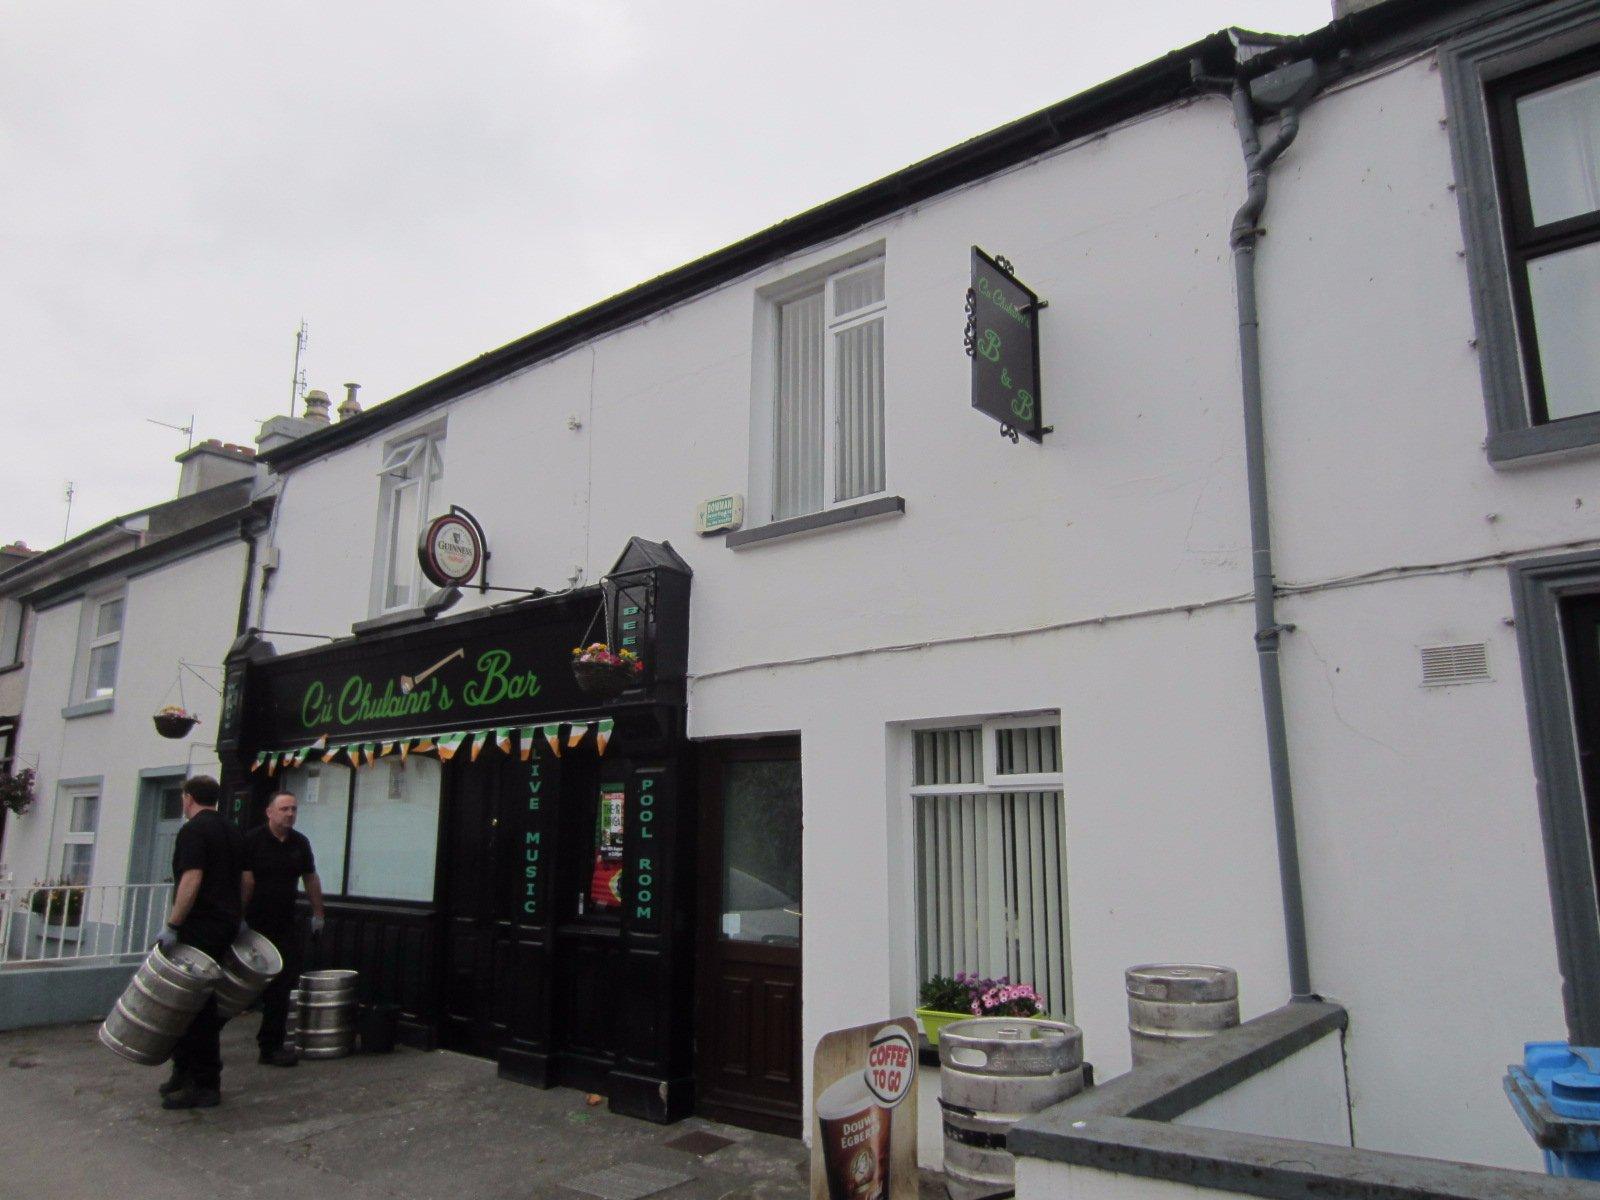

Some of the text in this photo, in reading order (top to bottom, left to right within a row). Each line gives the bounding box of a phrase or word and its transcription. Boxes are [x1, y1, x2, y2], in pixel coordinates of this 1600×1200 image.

[978, 328, 1034, 421] B & B
[338, 676, 454, 725] Chulainn's
[463, 649, 541, 707] Bar
[524, 832, 541, 914] MUSIC
[636, 779, 654, 919] POOL ROOM
[868, 1044, 909, 1068] COFFEE
[872, 1069, 902, 1093] TO GO
